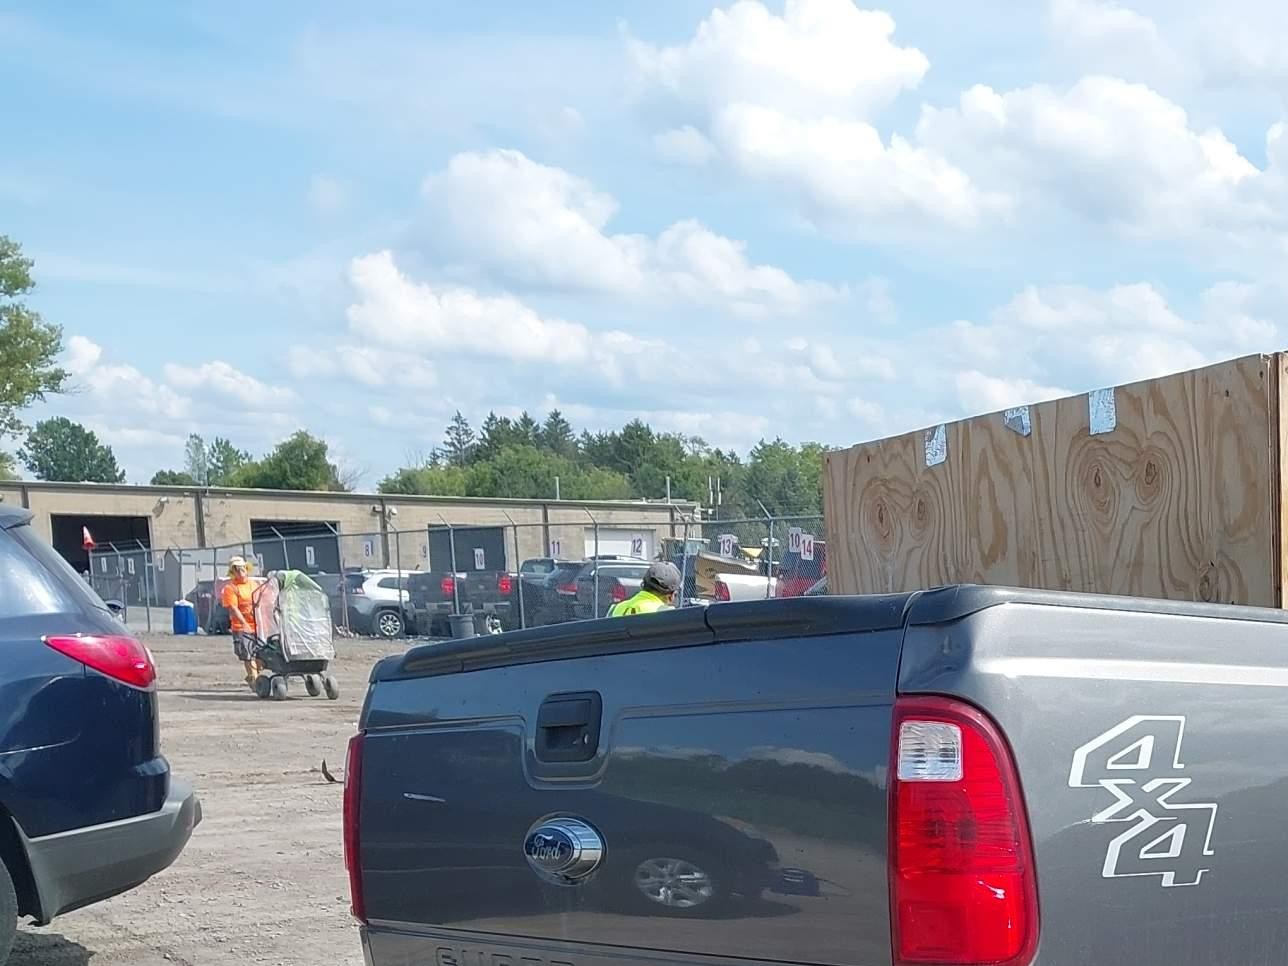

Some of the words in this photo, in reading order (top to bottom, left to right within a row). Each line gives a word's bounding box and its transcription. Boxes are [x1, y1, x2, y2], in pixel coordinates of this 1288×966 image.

[632, 539, 642, 553] 12
[790, 533, 799, 545] 10
[551, 540, 561, 555] 11
[721, 539, 731, 555] 13
[803, 540, 812, 555] 14
[531, 833, 562, 860] Ford
